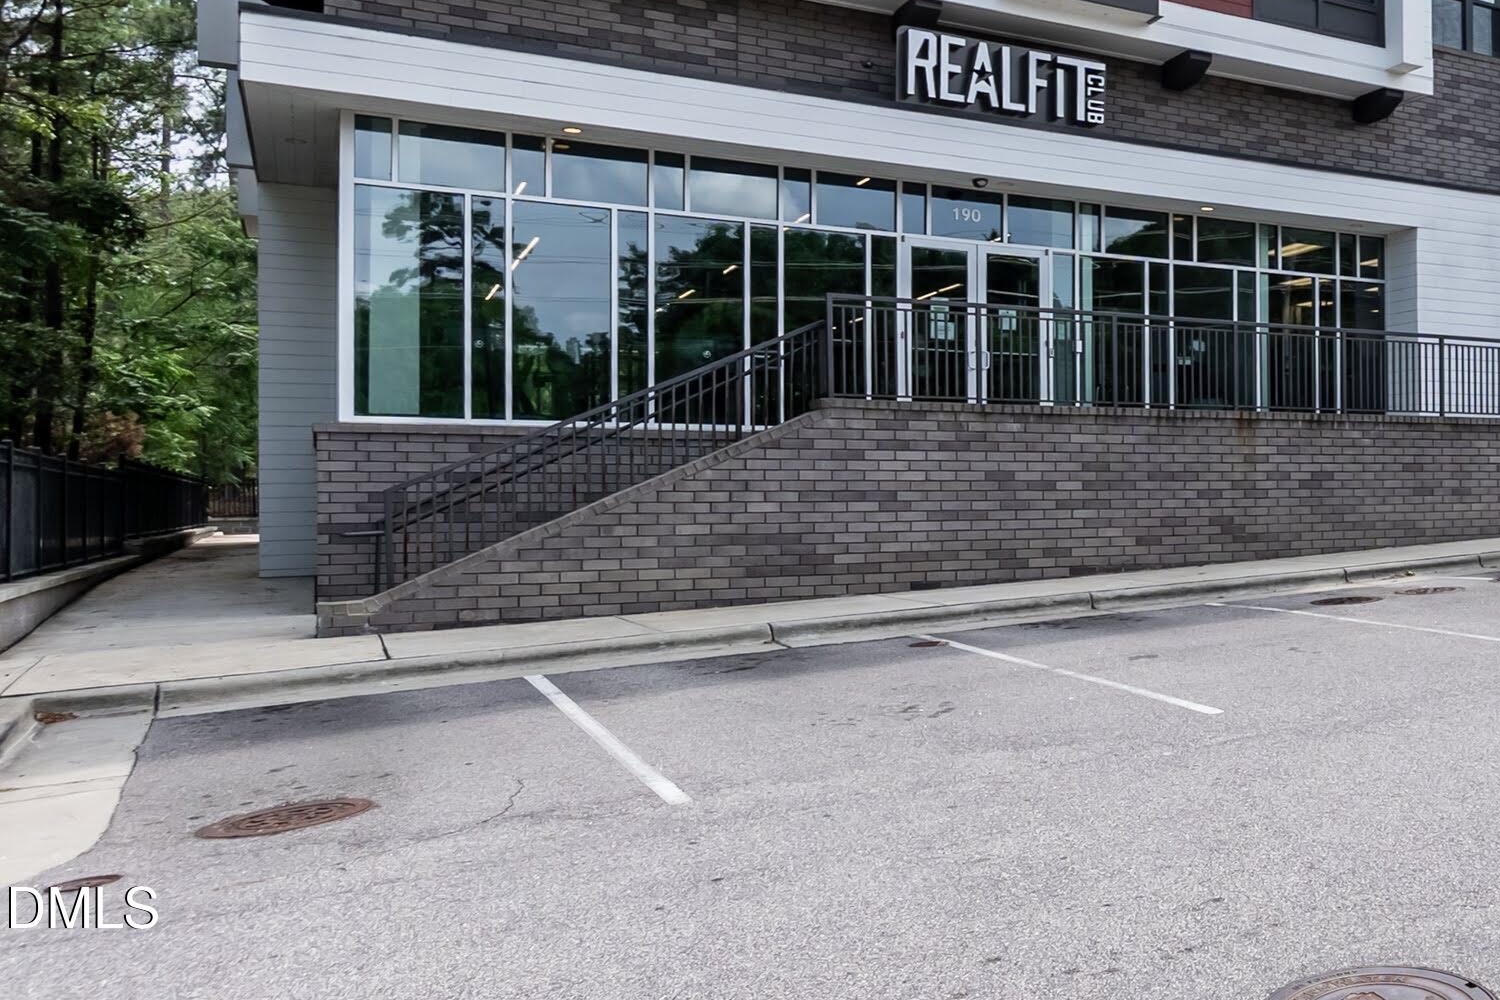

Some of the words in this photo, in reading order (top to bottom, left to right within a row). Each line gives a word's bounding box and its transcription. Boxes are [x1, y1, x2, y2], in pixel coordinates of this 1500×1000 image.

[907, 28, 1106, 122] REALFIT
[1087, 74, 1105, 124] CLUB
[953, 207, 981, 222] 190
